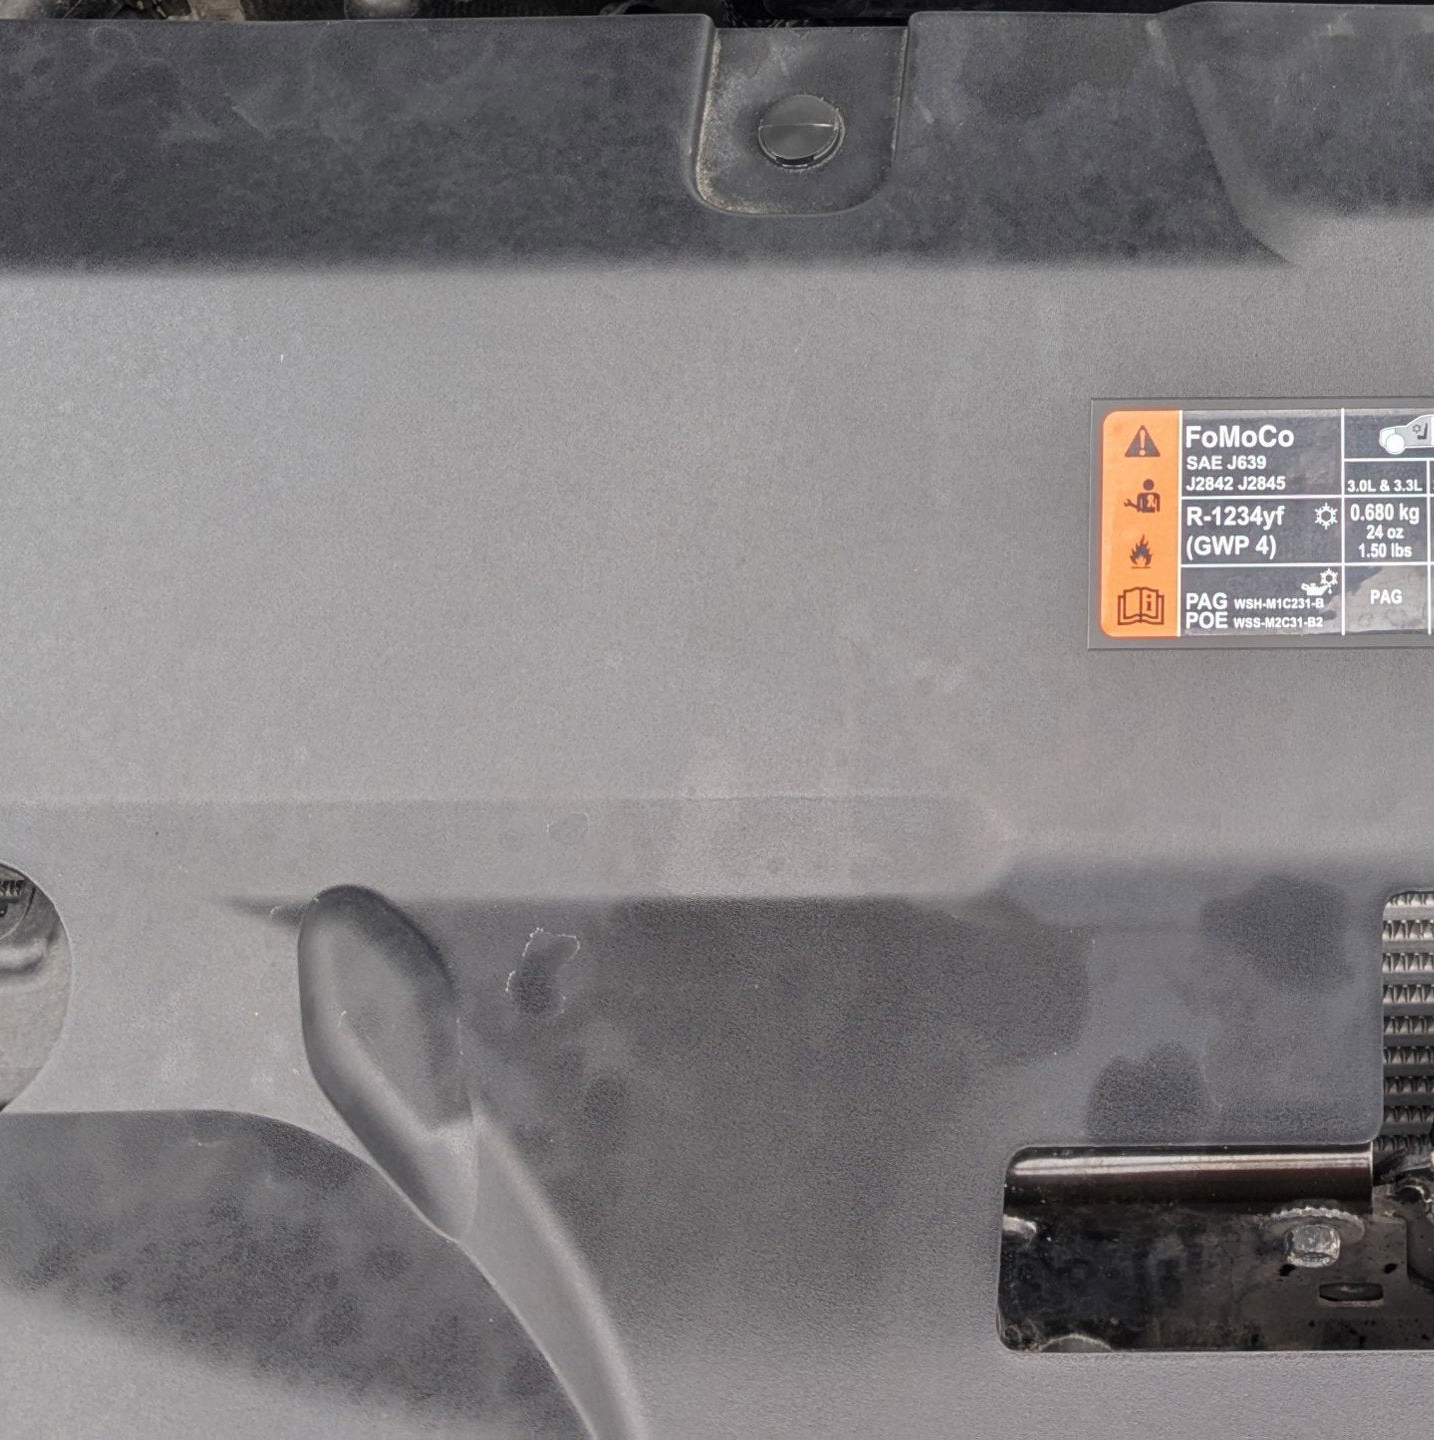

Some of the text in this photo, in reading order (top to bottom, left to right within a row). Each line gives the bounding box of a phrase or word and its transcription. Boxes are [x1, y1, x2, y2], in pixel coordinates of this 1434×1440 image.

[1186, 425, 1294, 447] FoMoCo
[1186, 456, 1267, 470] SAE J639
[1186, 476, 1285, 490] J2842 J2845
[1348, 479, 1422, 492] 3.0L & 3.3L
[1187, 506, 1285, 530] R-1234yf
[1350, 503, 1419, 524] 0.680 kg
[1367, 525, 1404, 539] 24 oz
[1186, 535, 1276, 561] (GWP 4)
[1359, 543, 1412, 558] 1.50 lbs
[1186, 593, 1324, 610] PAG WSH-M1C231-B
[1370, 589, 1402, 604] PAG
[1186, 612, 1323, 628] POE WSS-M2C31-B2
